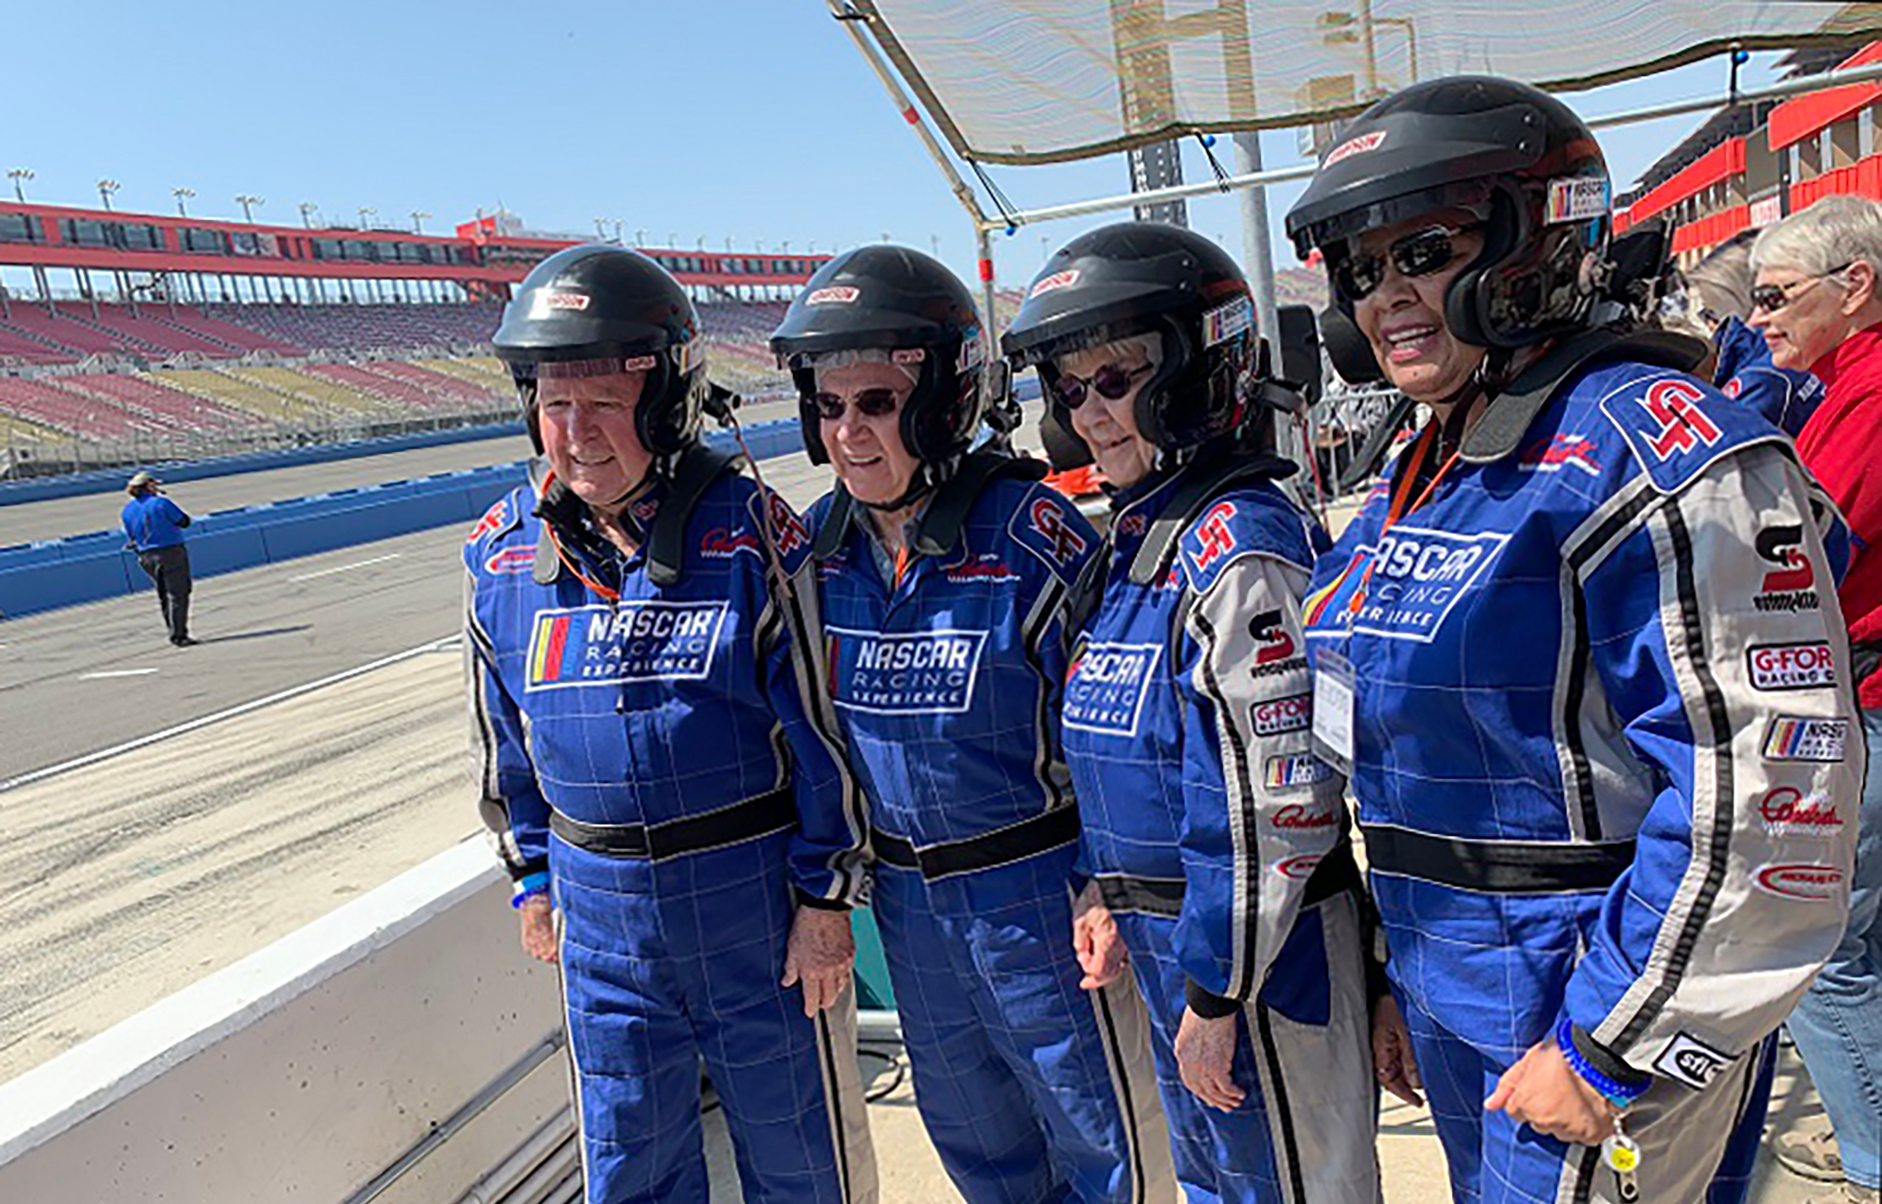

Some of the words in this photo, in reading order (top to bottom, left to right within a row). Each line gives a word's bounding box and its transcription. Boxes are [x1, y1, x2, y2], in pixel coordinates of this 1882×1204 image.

[1374, 536, 1482, 581] ASCAR
[1377, 583, 1452, 605] CING
[588, 609, 715, 643] NASCAR
[585, 639, 706, 661] RACING
[856, 639, 972, 669] NASCAR
[1755, 646, 1833, 672] G-FOR
[852, 671, 966, 689] RACING
[1079, 652, 1145, 685] ASCAR
[1758, 670, 1819, 685] RACING
